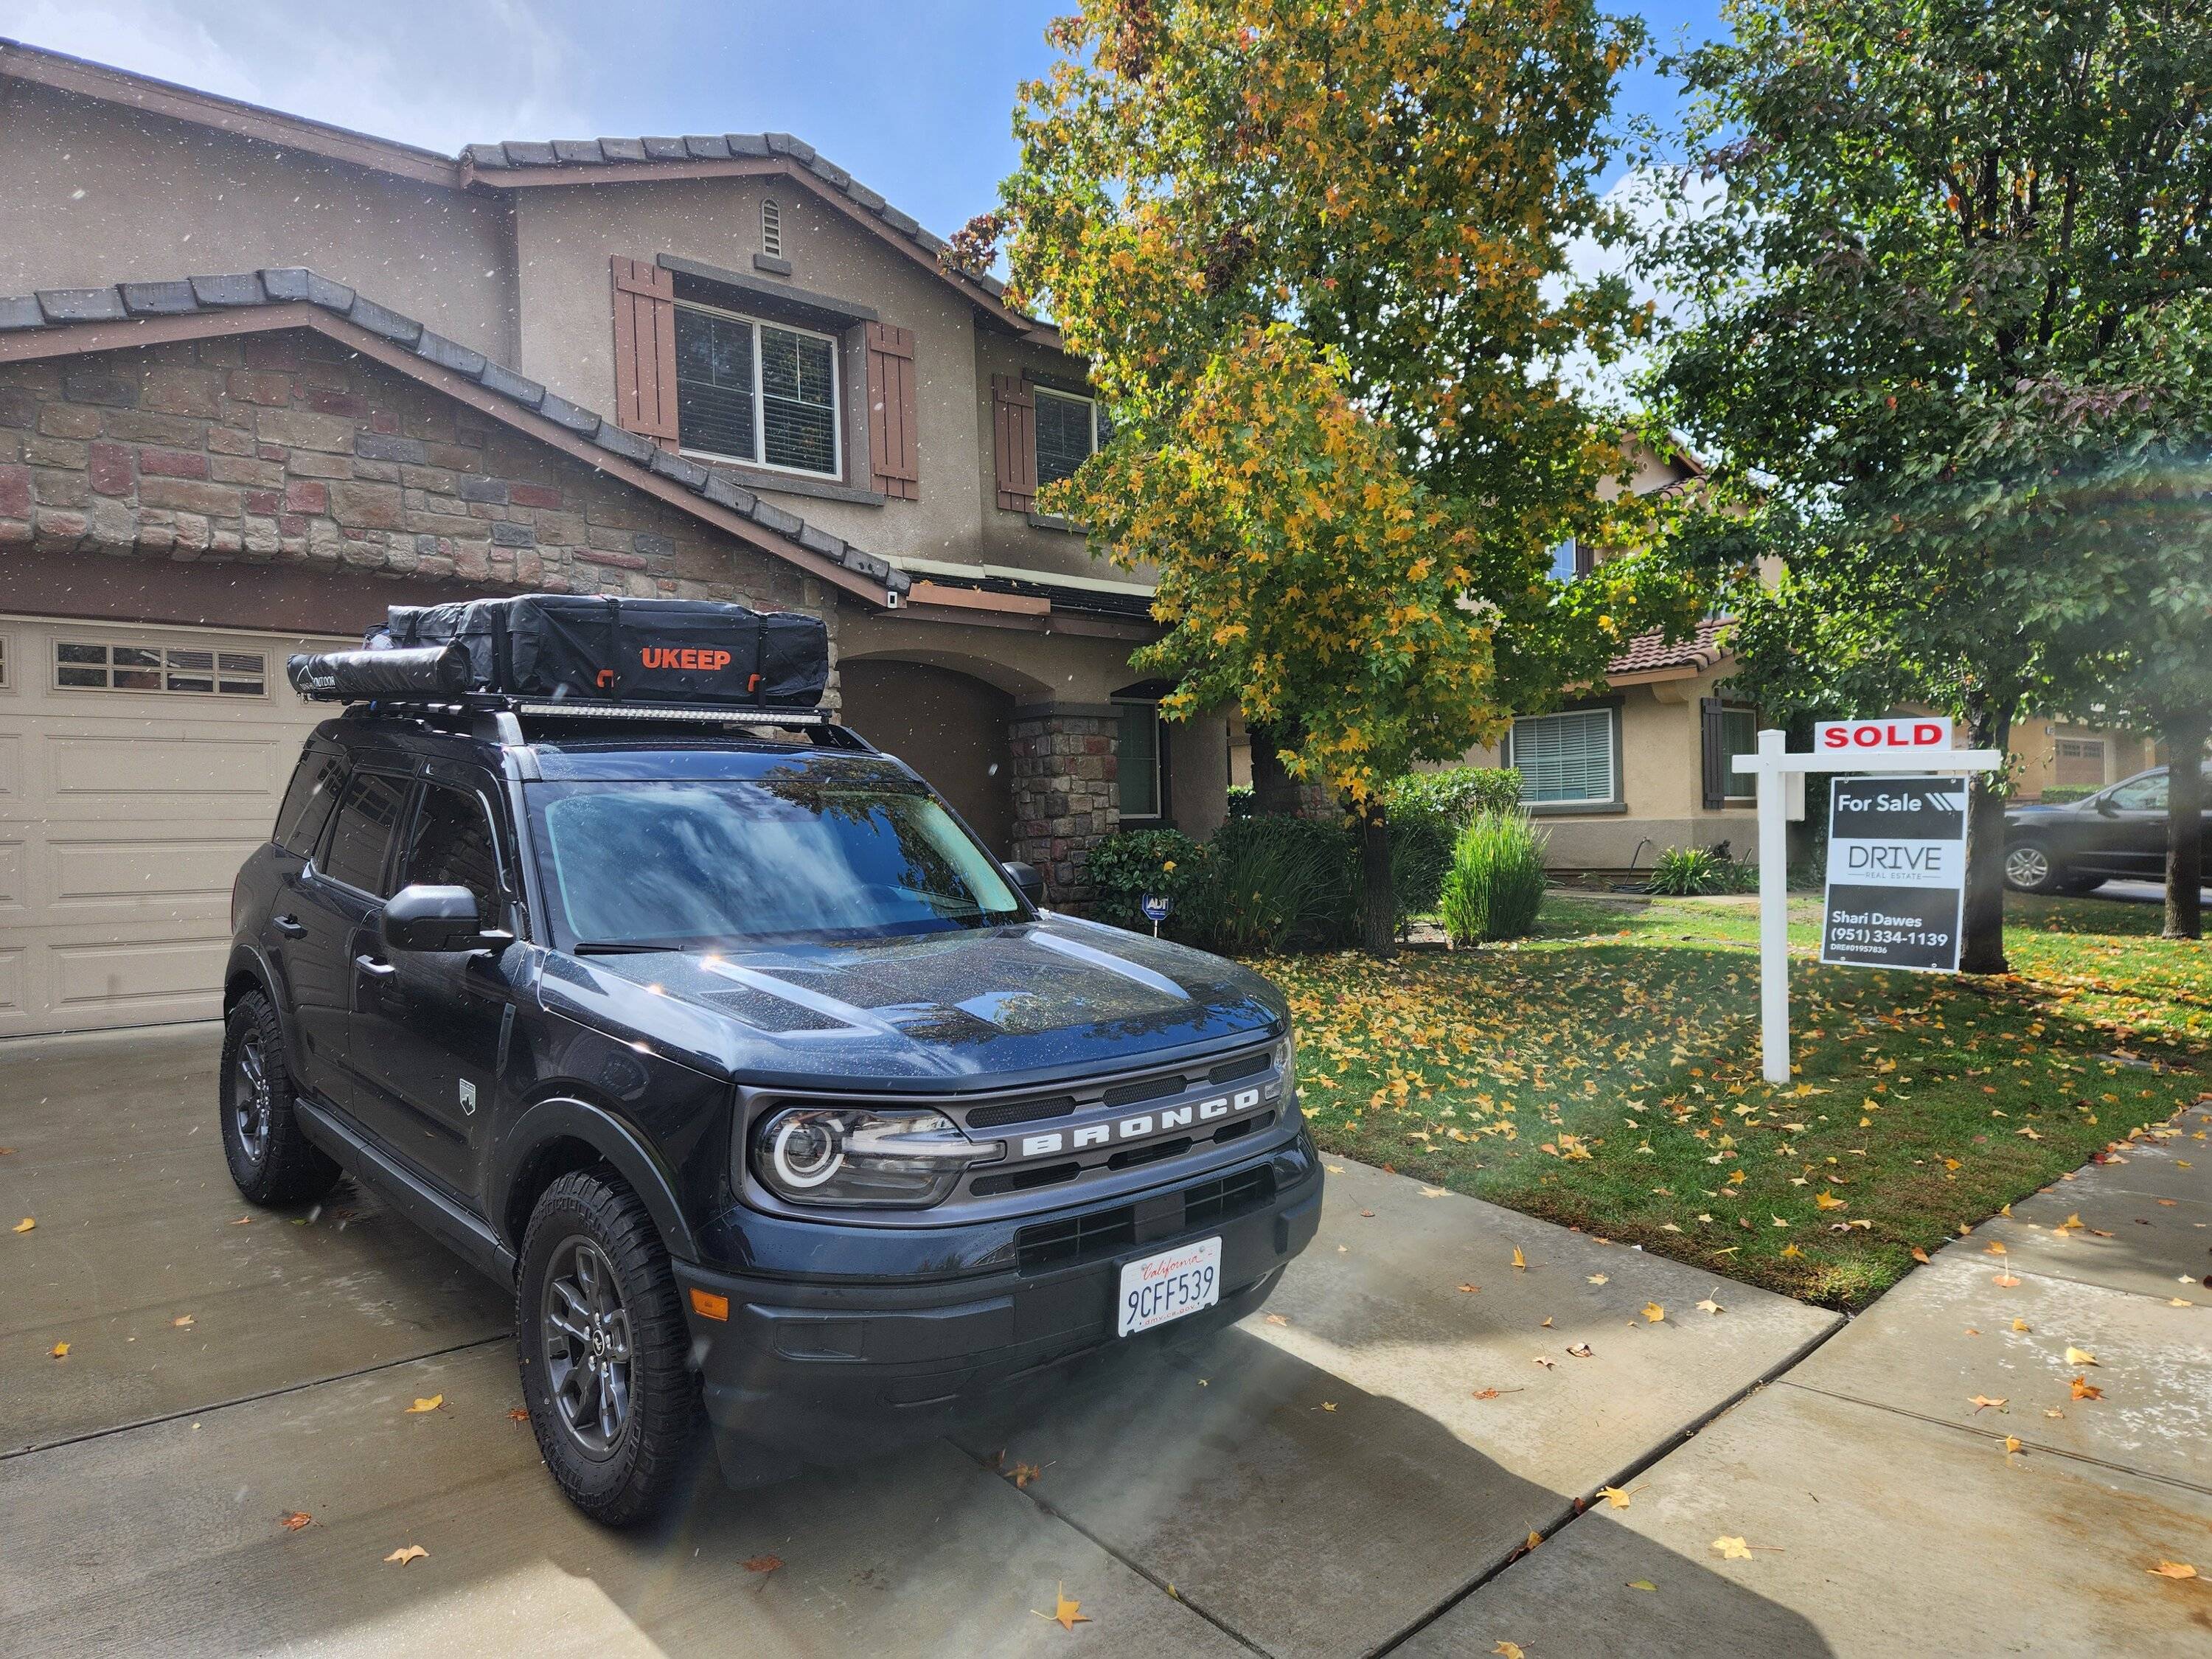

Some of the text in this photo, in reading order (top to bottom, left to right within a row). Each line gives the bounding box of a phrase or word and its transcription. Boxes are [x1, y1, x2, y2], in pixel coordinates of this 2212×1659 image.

[642, 647, 731, 670] UKEEP
[1824, 724, 1943, 748] SOLD
[1838, 793, 1922, 811] For Sale
[1849, 846, 1941, 870] DRIVE
[1147, 897, 1168, 910] ADT
[1832, 911, 1922, 928] Shari Dawes
[1831, 928, 1948, 946] (951) 334-1139
[1023, 1089, 1258, 1156] BRONCO
[1144, 1255, 1203, 1280] California
[1127, 1266, 1214, 1325] 9CFF539
[1144, 1304, 1195, 1325] dmv.ca.gov
